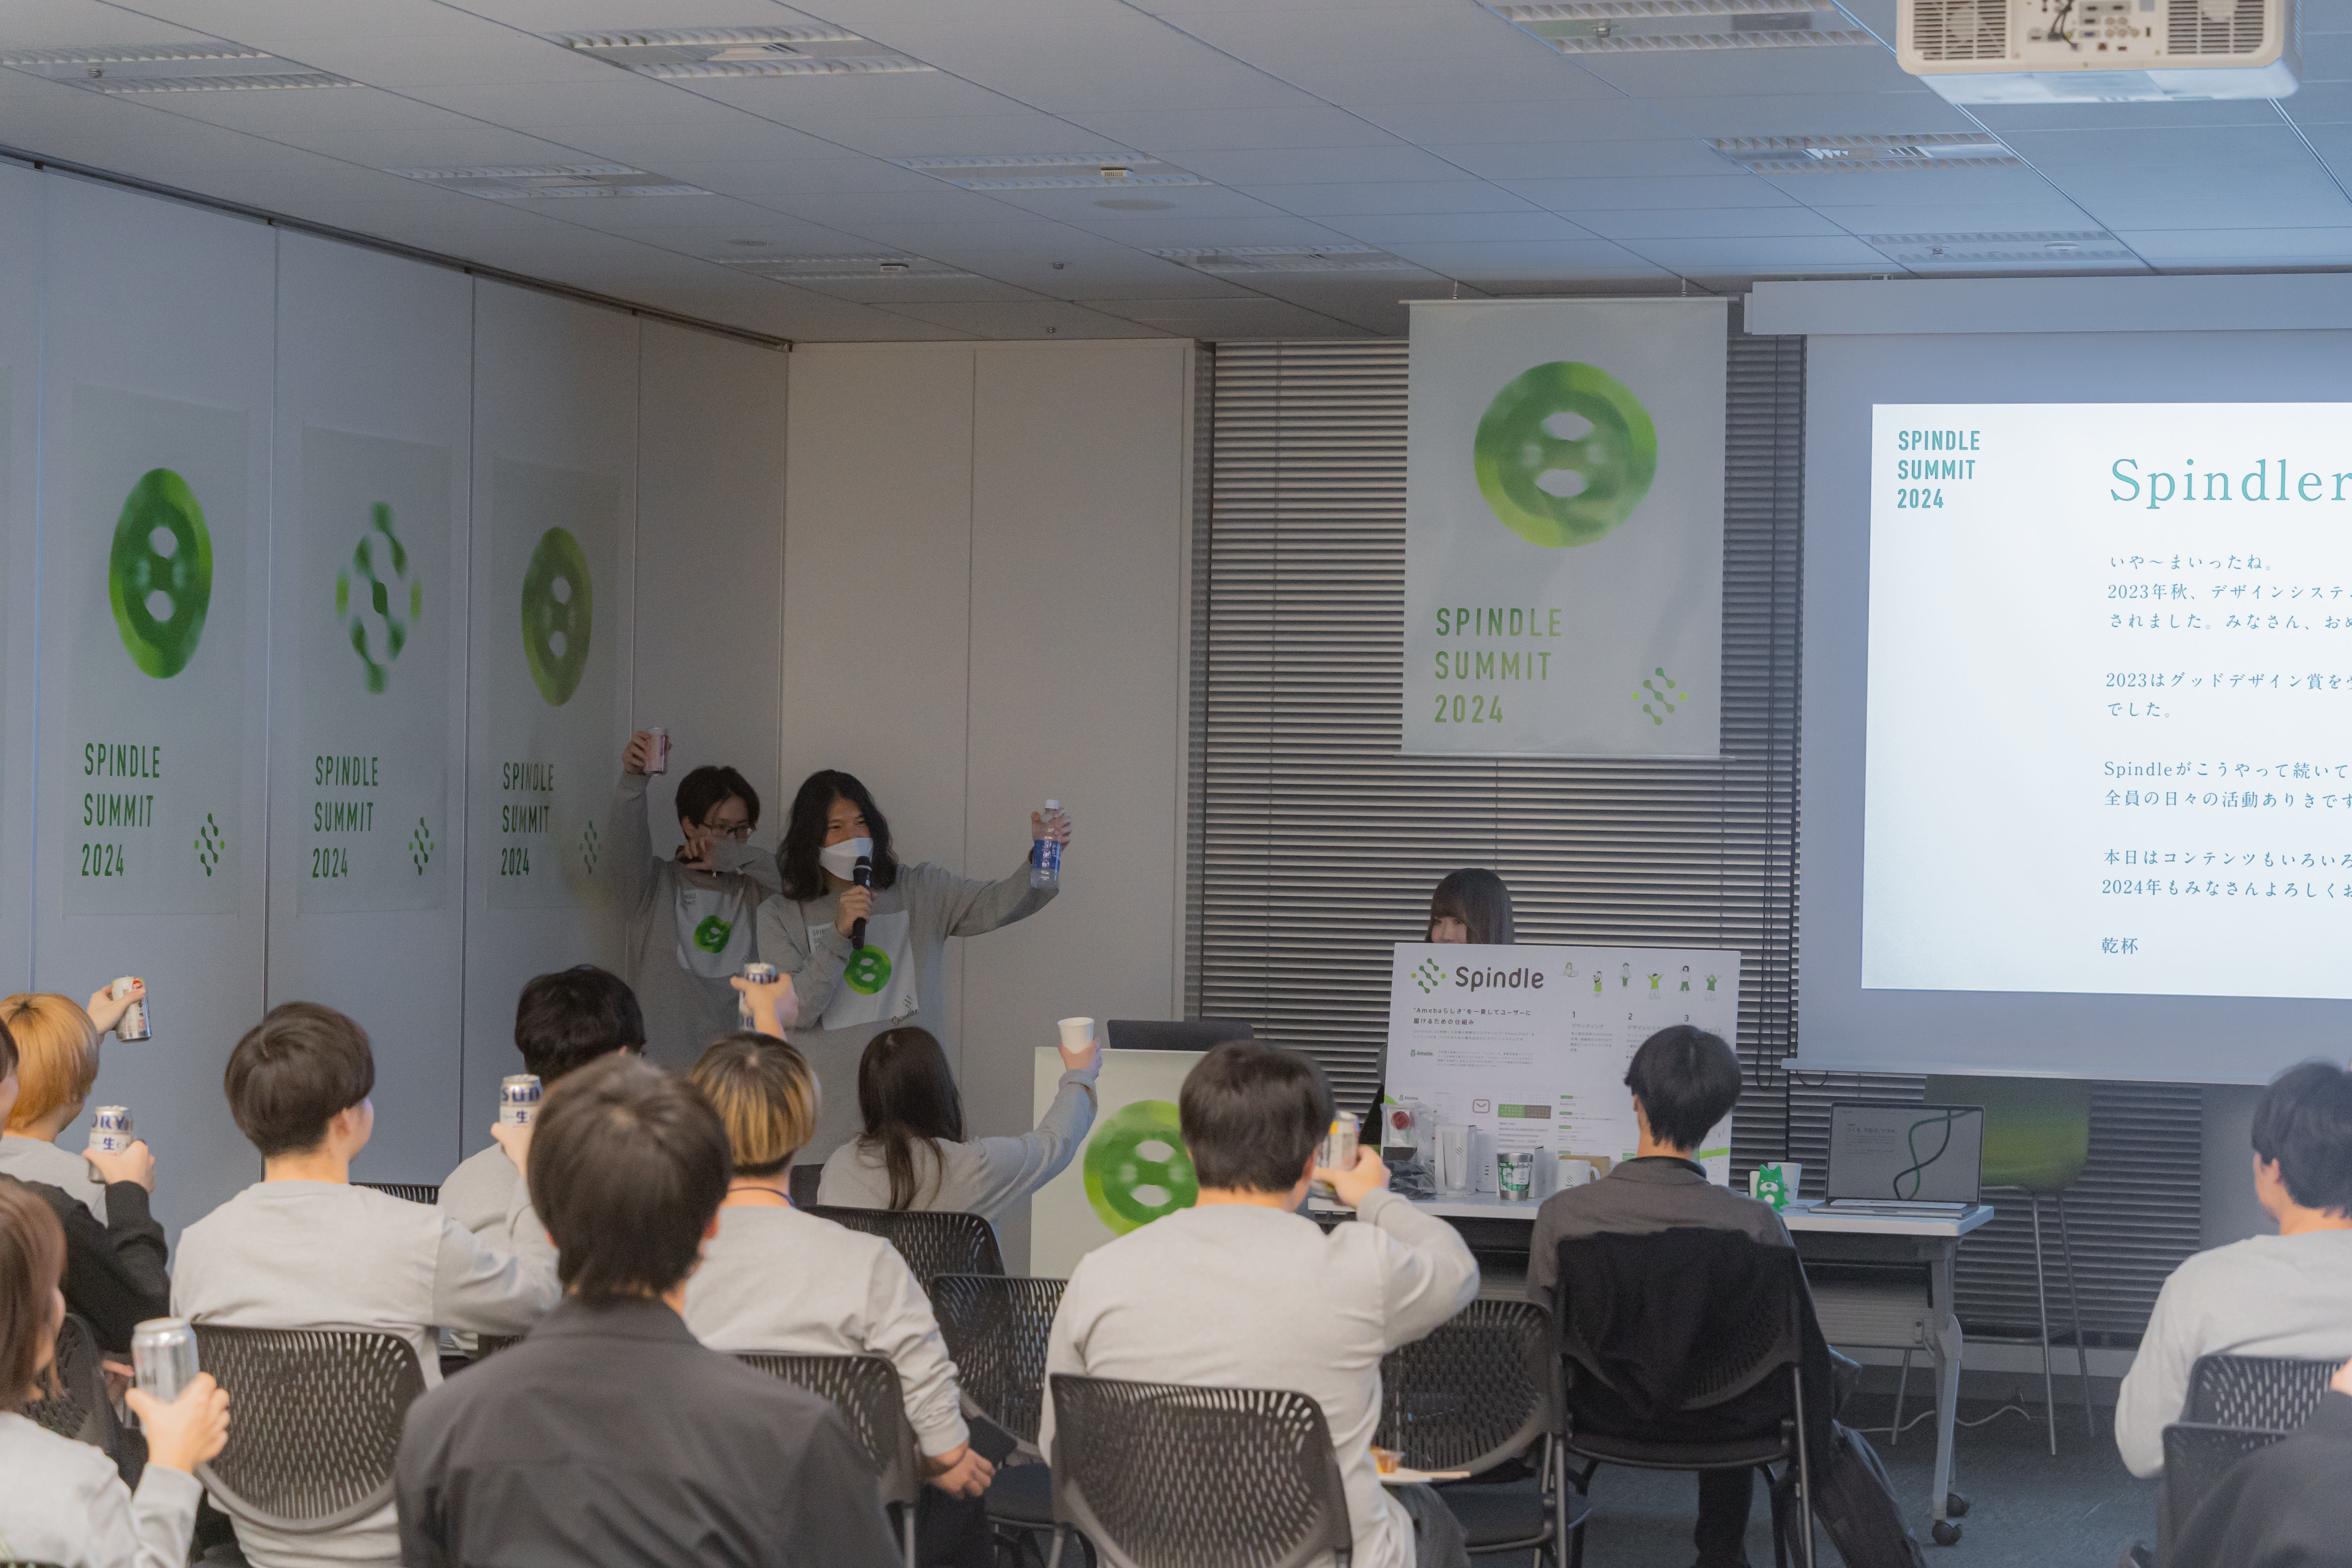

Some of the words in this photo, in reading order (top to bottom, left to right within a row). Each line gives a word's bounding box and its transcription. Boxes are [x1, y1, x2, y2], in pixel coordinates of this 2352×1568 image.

[1898, 430, 1980, 451] SPINDLE
[1898, 459, 1976, 480] SUMMIT
[2110, 458, 2352, 510] Spindler
[1897, 488, 1944, 509] 2024
[2108, 583, 2352, 600] 2023年秋、デザインシステ
[1436, 607, 1562, 636] SPINDLE
[1435, 650, 1551, 681] SUMMIT
[1434, 694, 1503, 724] 2024
[2107, 701, 2171, 718] でした。
[84, 742, 160, 778] SPINDLE
[315, 755, 378, 787] SPINDLE
[2104, 761, 2348, 779] Spindleがこうやって続いて
[503, 762, 554, 791] SPINDLE
[83, 793, 154, 828] SUMMIT
[314, 802, 374, 832] SUMMIT
[503, 805, 550, 833] SUMMIT
[82, 843, 124, 877] 2024
[312, 848, 348, 878] 2024
[501, 848, 530, 876] 2024
[2102, 937, 2138, 955] 乾杯
[1455, 966, 1544, 993] Spindle
